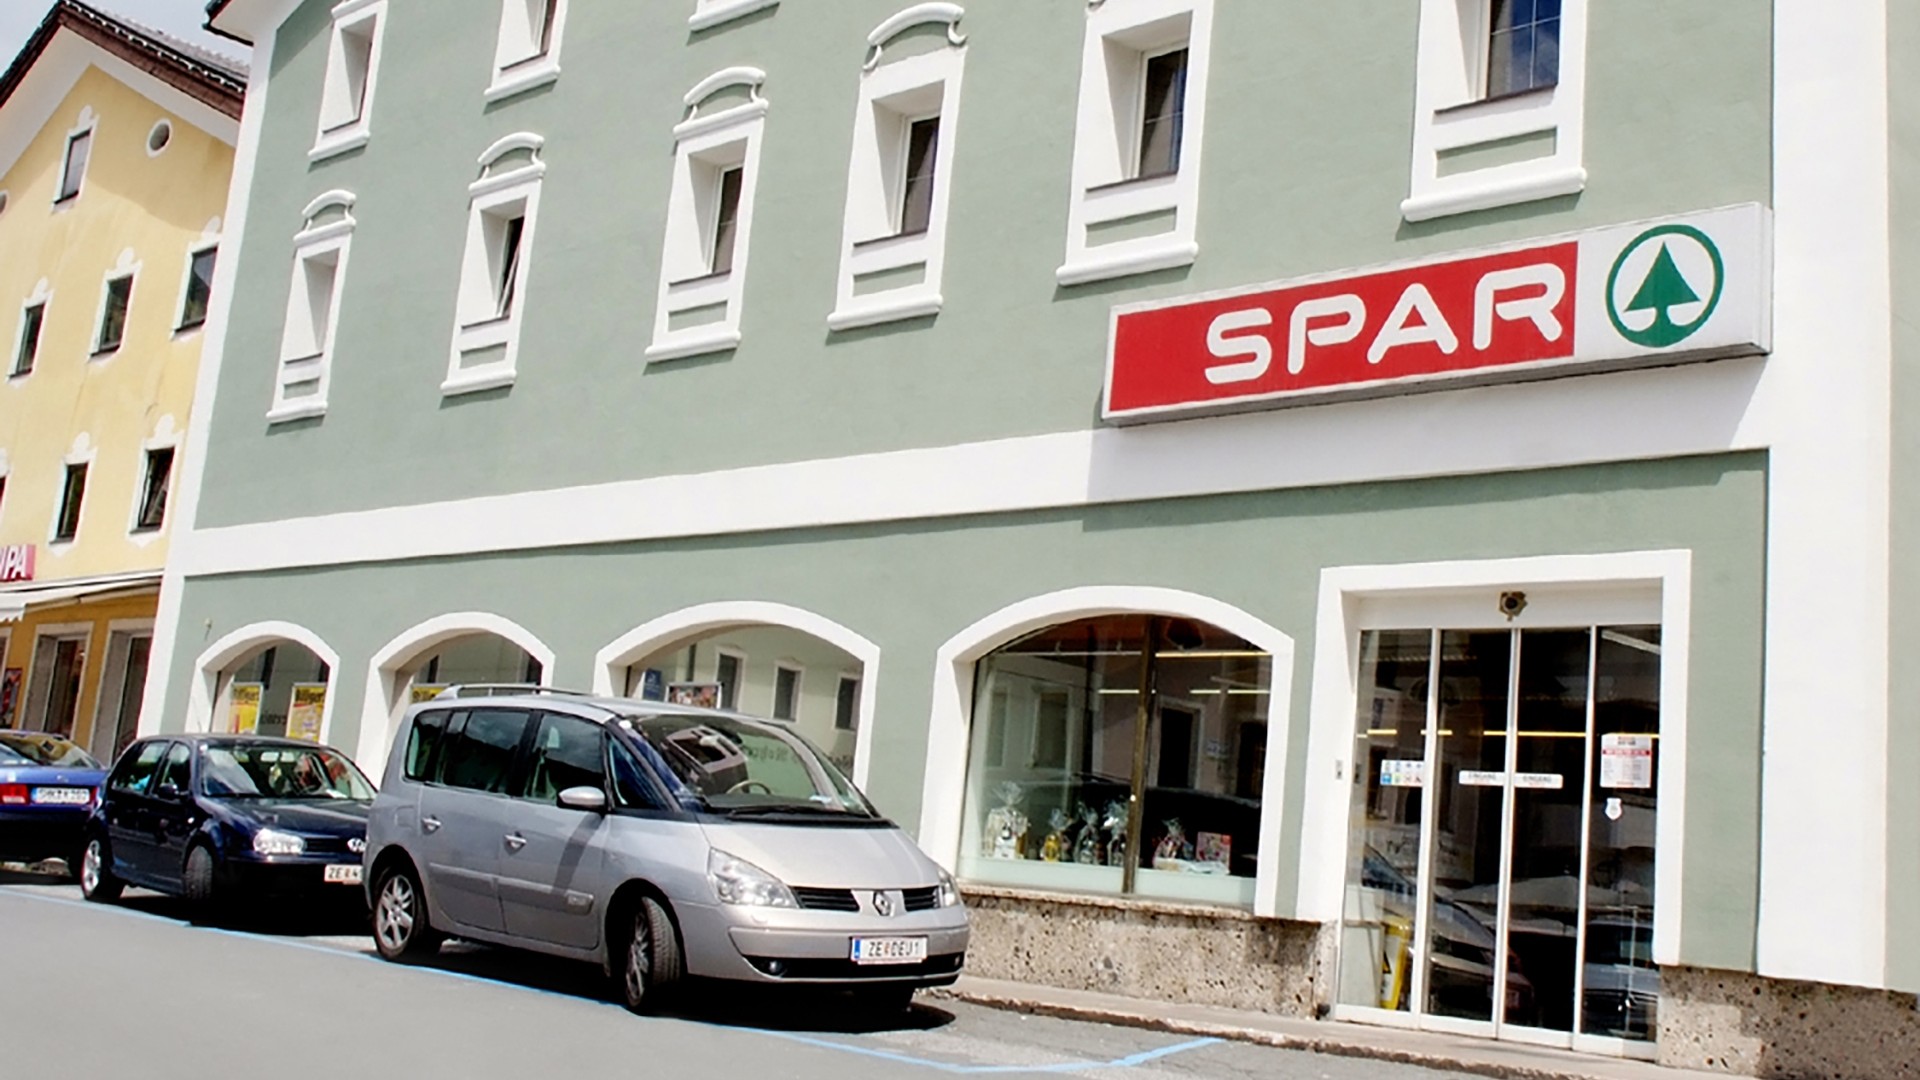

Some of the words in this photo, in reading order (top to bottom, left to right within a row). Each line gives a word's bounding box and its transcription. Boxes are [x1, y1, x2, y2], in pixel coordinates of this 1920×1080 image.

[1204, 262, 1566, 385] SPAR
[0, 544, 26, 580] IPA
[868, 941, 883, 957] ZE
